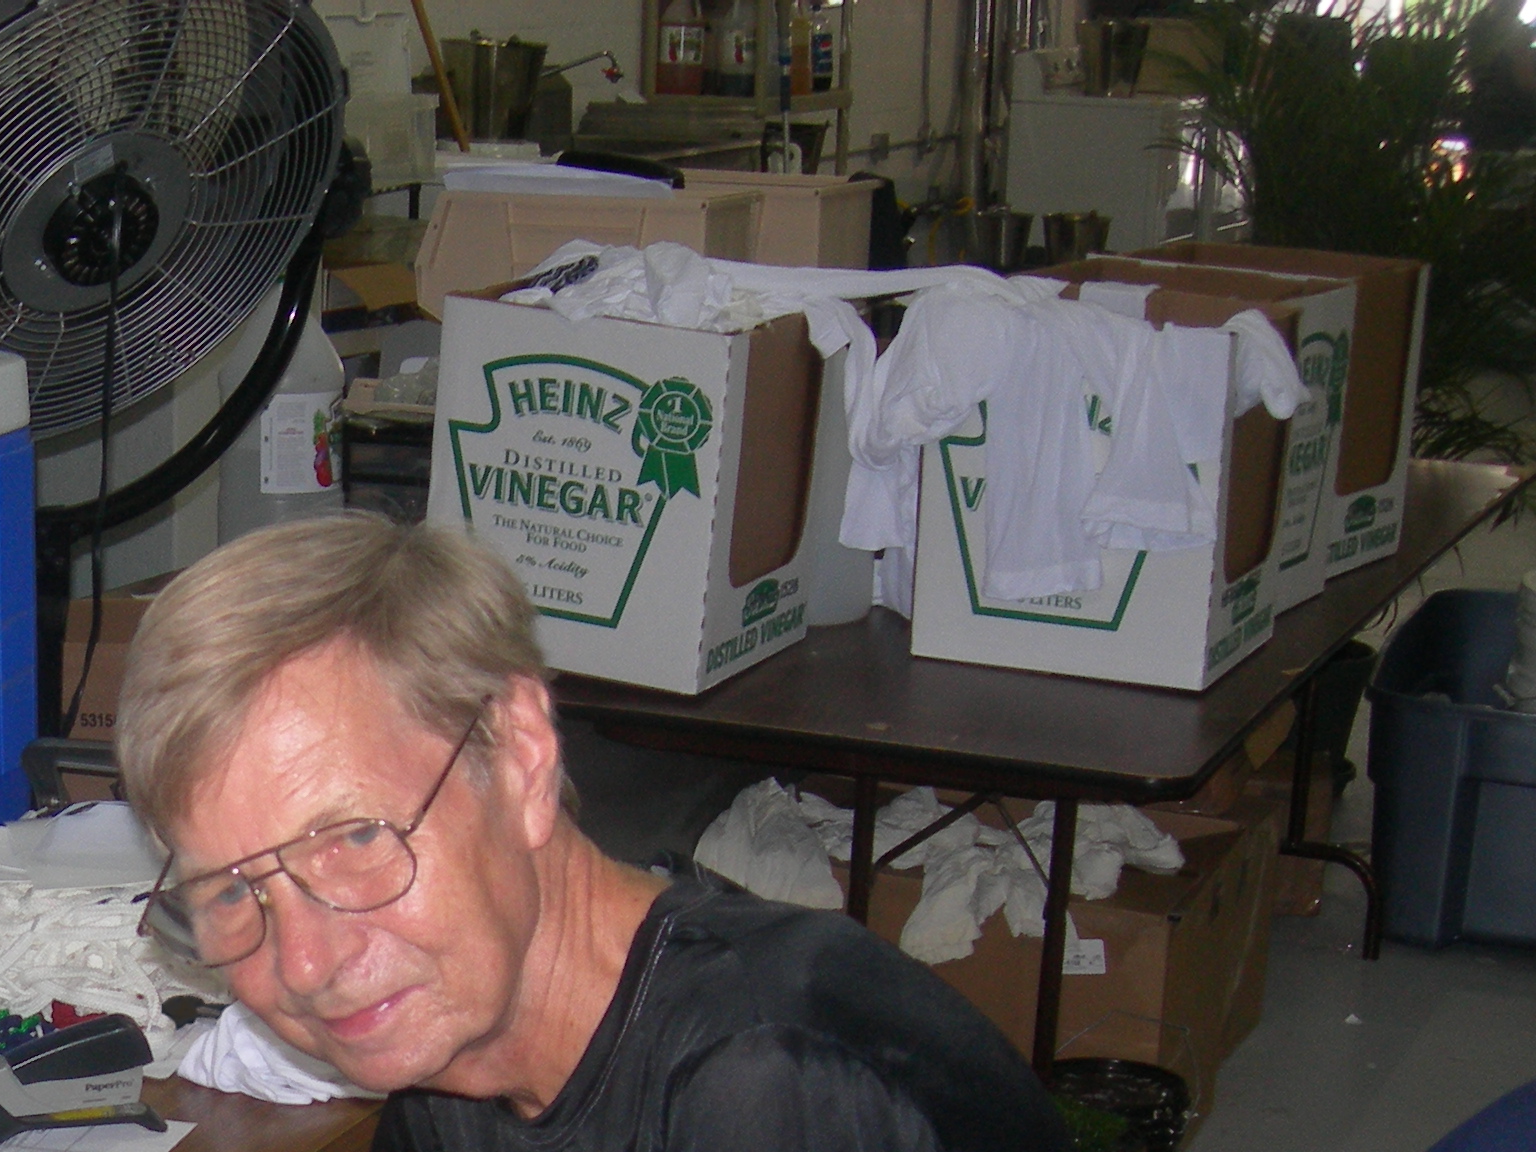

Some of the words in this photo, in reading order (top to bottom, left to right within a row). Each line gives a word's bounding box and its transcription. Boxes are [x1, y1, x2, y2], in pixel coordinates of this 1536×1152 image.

[508, 377, 633, 434] HEINZ
[532, 430, 555, 446] Est.
[561, 436, 592, 453] 1869
[504, 449, 622, 483] DISTILLED
[493, 514, 517, 529] THE
[520, 519, 573, 539] NATURAL
[576, 528, 624, 547] CHOICE
[526, 532, 550, 547] FOR
[553, 537, 587, 553] FOOD
[516, 553, 536, 567] 5%
[539, 557, 589, 579] Acidity
[533, 584, 583, 605] LITERS
[706, 626, 758, 674] DISTILLED
[761, 601, 807, 645] VINEGAR
[85, 1080, 132, 1092] PaperPro
